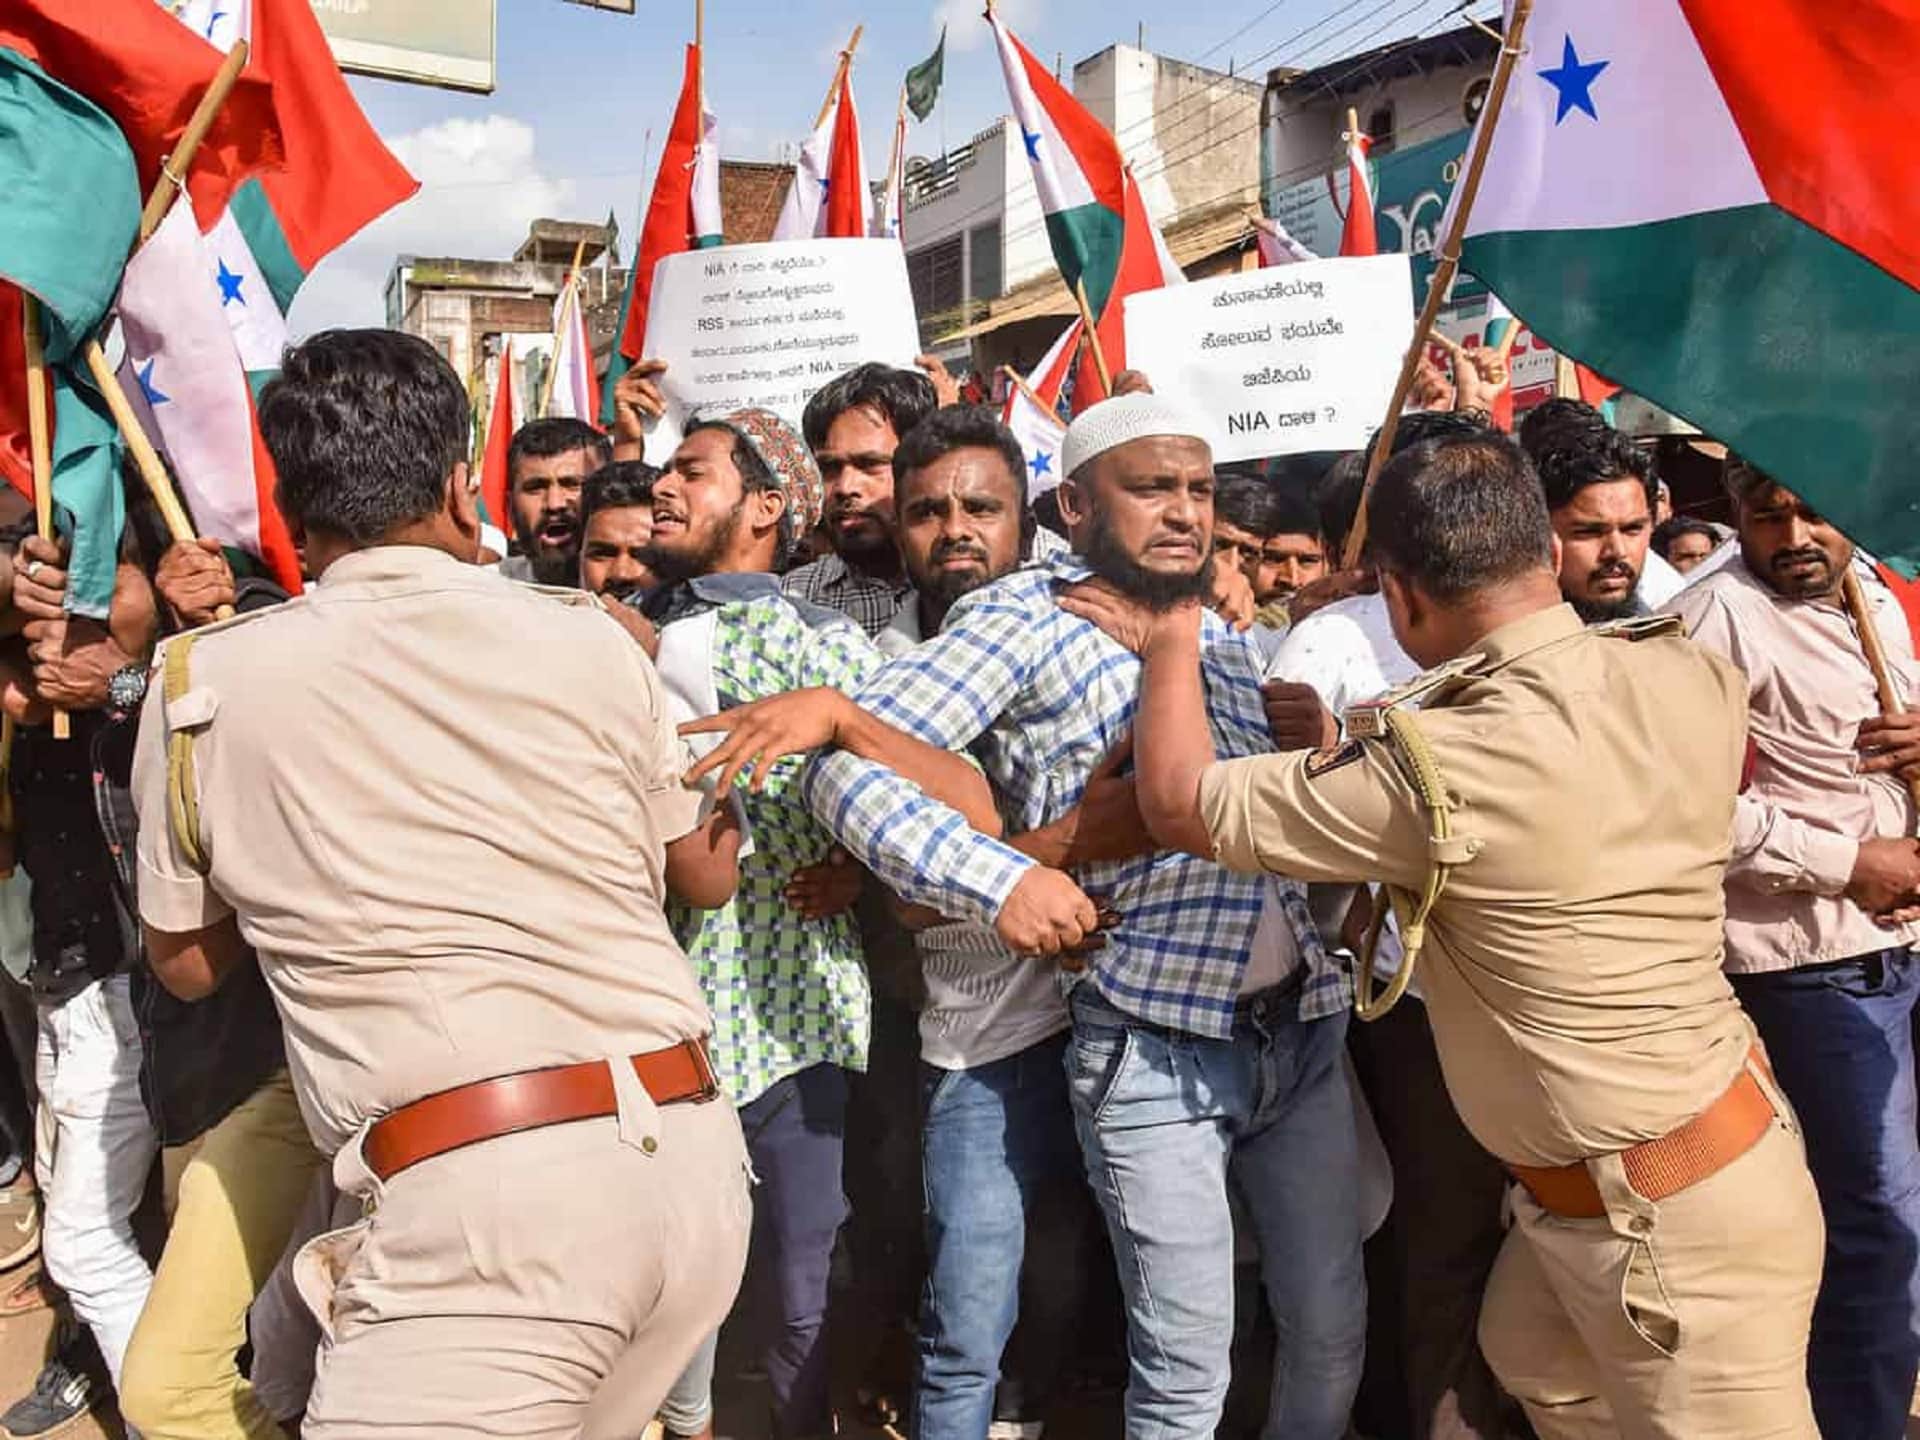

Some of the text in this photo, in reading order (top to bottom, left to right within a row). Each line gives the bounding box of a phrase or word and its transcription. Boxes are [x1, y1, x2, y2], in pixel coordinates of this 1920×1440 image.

[704, 261, 726, 277] NIA
[1212, 279, 1324, 308] ಚುನಾವಣೆಯಲ್ಲಿ
[698, 316, 724, 331] RSS
[1201, 318, 1344, 350] ಸೋಲುವ ಭಯವೇ
[809, 360, 834, 374] NIA
[1242, 364, 1311, 388] ಬಿಜೆಪಿಯ
[1227, 407, 1336, 435] NIA ದಾಳಿ ?
